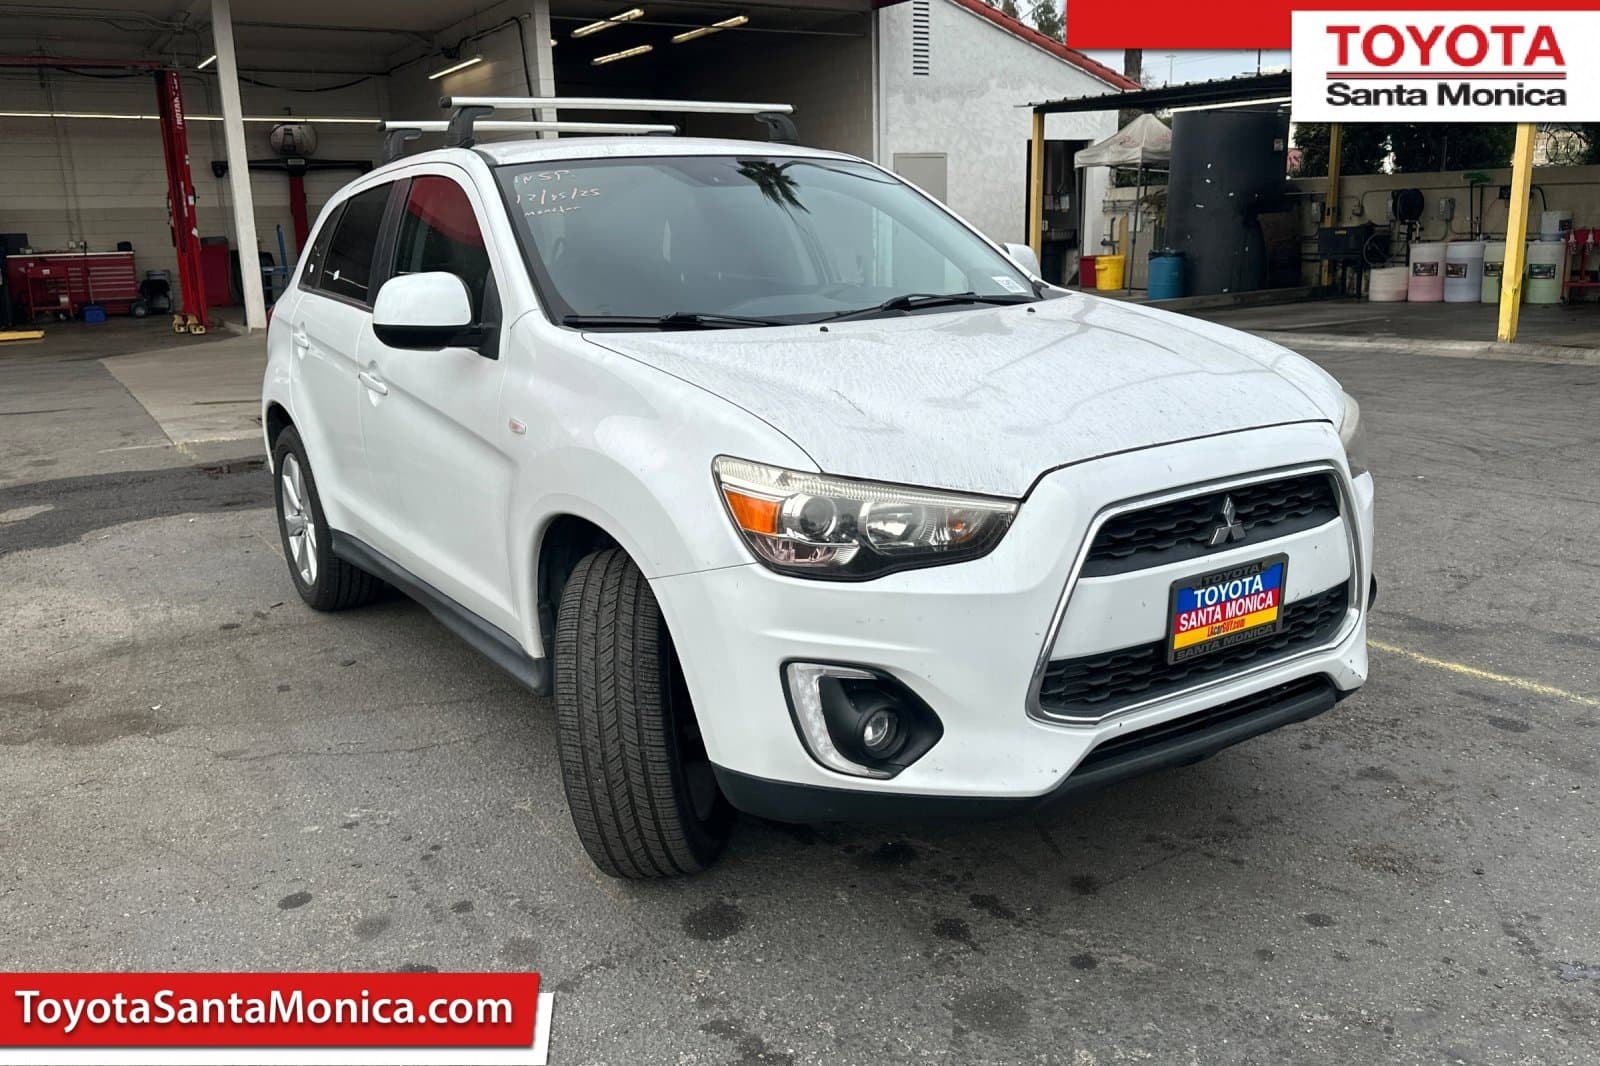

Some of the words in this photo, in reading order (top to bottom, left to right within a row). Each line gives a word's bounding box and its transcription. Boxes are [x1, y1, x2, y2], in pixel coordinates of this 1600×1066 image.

[1194, 574, 1263, 608] TOYOTA
[1204, 564, 1260, 584] TOYOTA
[1179, 605, 1222, 632] SANTA
[1225, 590, 1273, 619] MONICA
[1176, 640, 1221, 660] SANTA
[1223, 624, 1273, 646] MONICA
